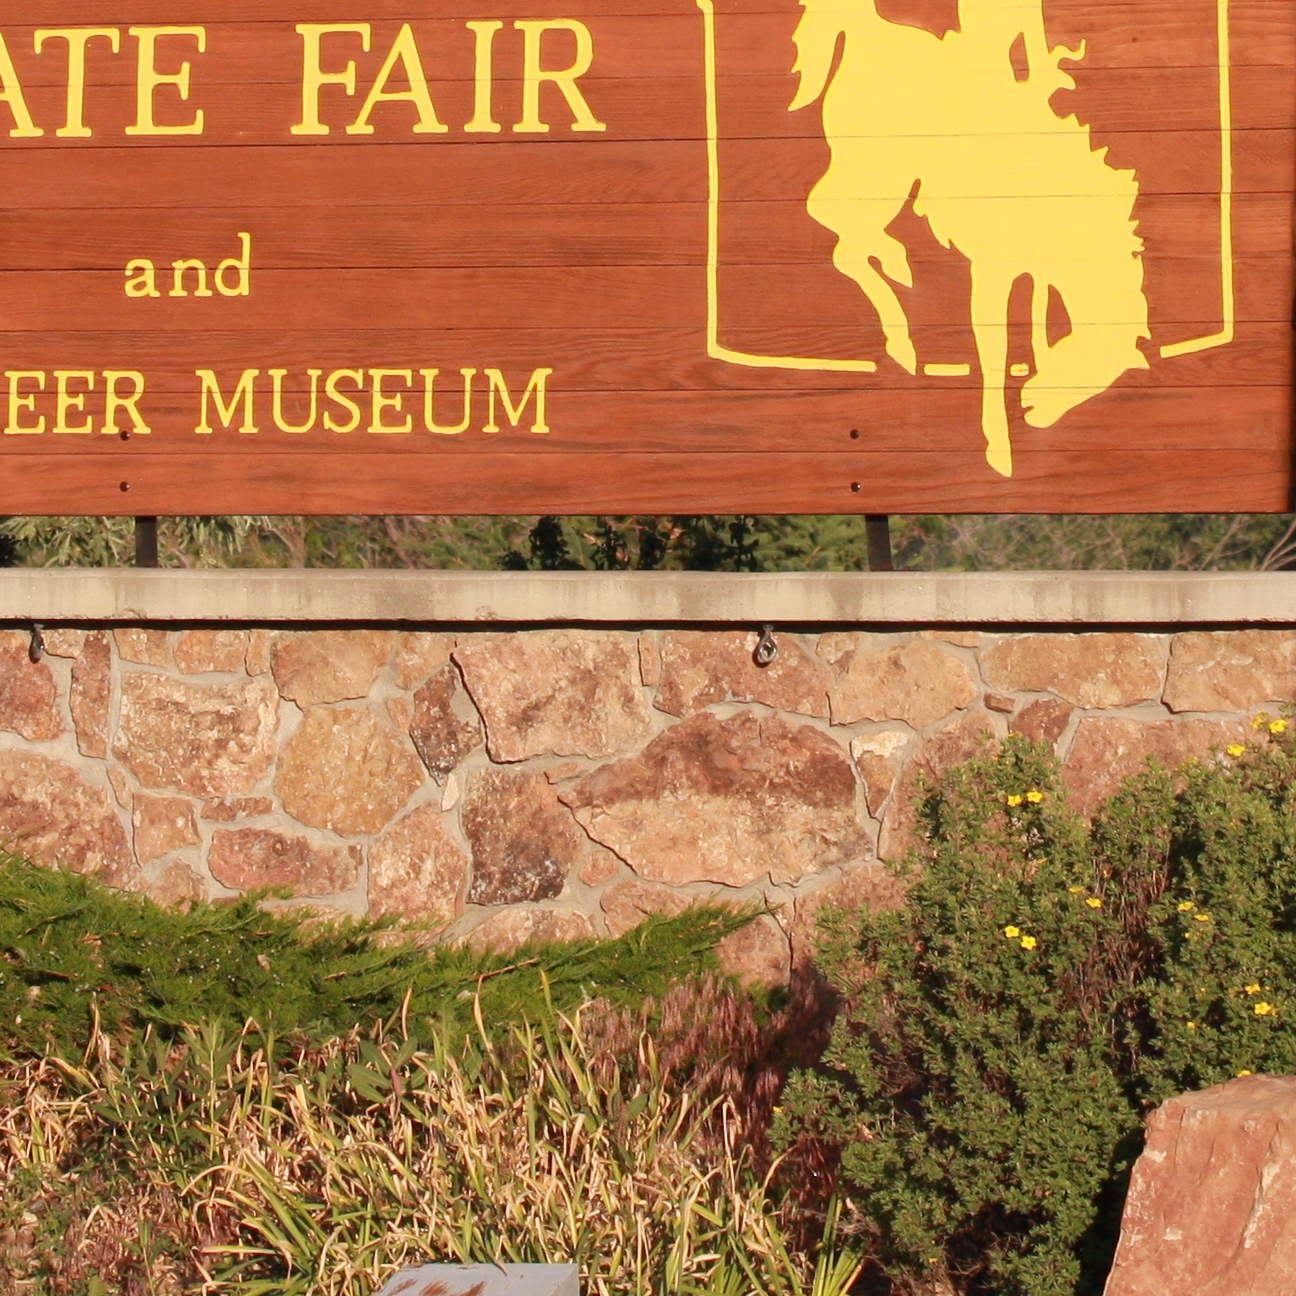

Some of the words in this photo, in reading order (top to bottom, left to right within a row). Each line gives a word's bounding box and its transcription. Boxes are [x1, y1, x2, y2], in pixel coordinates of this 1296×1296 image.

[290, 18, 607, 136] FAIR
[124, 231, 253, 299] and
[194, 367, 553, 434] MUSEUM
